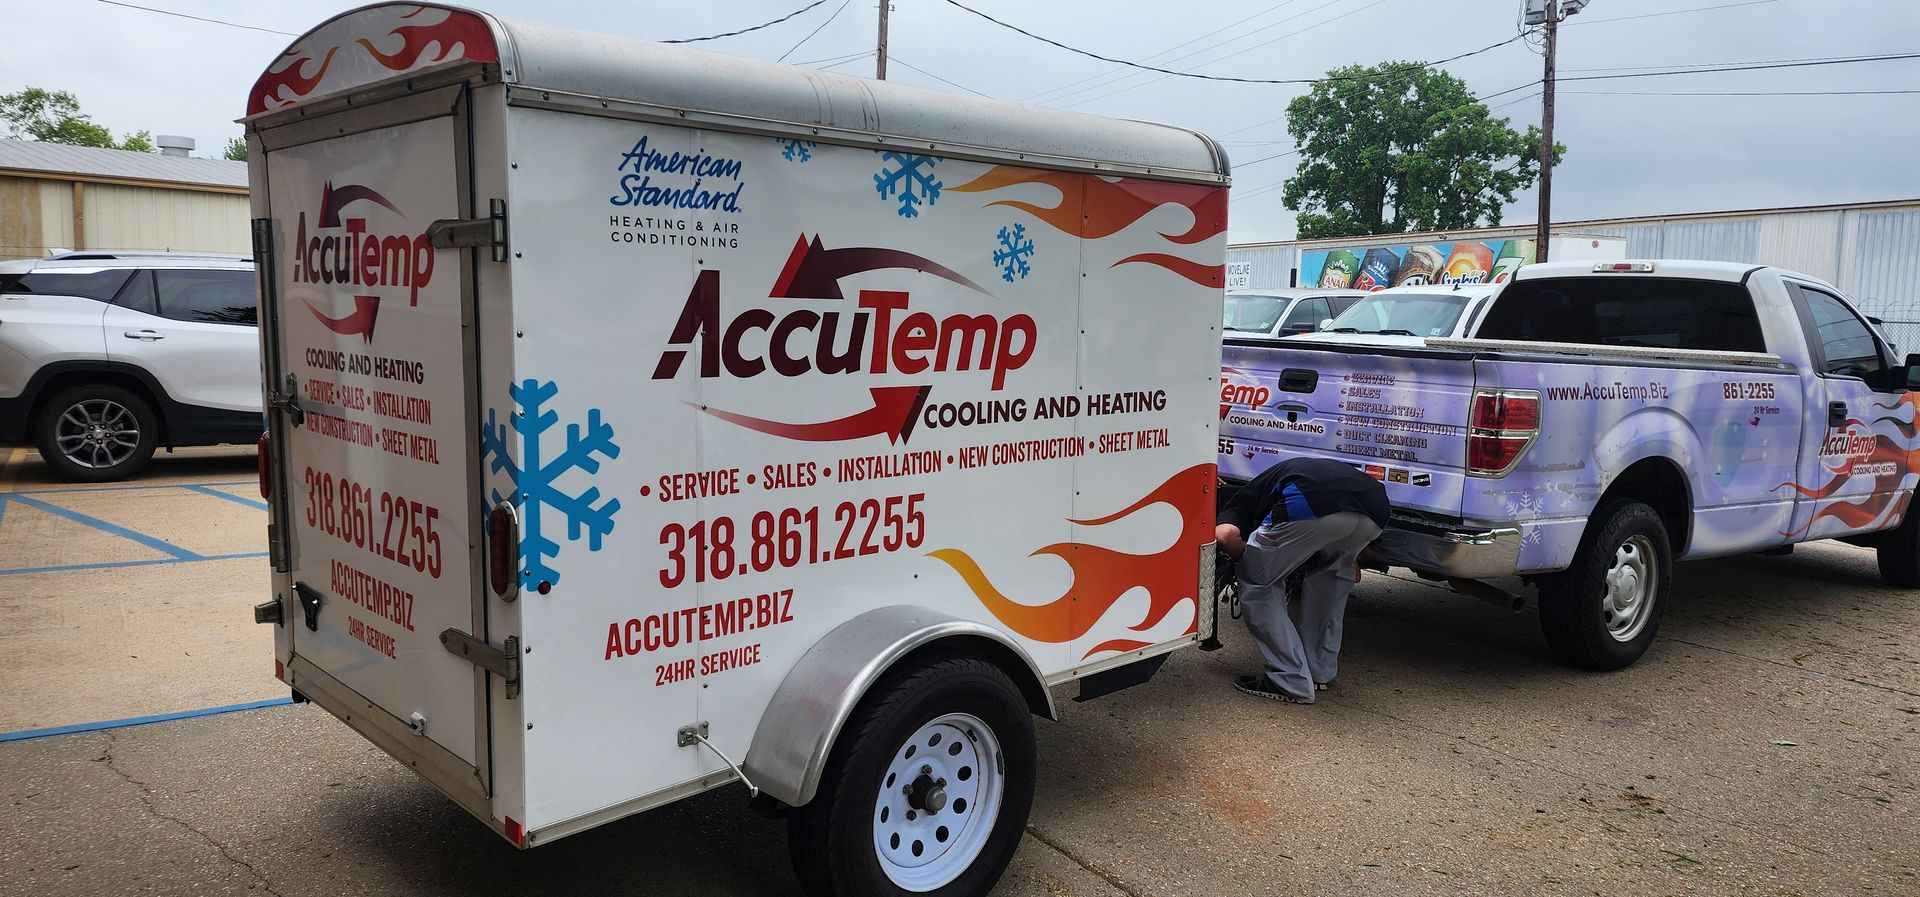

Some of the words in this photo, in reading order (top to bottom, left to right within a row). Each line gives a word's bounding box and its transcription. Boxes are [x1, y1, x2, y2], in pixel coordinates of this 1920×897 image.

[618, 135, 741, 181] American
[610, 174, 744, 213] Standard
[610, 216, 685, 230] HEATING
[696, 221, 704, 231] &
[713, 223, 739, 234] AIR
[611, 232, 738, 248] CONDITIONING
[293, 212, 434, 307] AccuTemp
[1229, 277, 1246, 287] LIVE!
[651, 270, 1037, 391] AccuTemp
[306, 347, 345, 372] COOLING
[349, 354, 371, 376] AND
[374, 357, 424, 384] HEATING
[309, 379, 335, 404] SERVICE
[342, 385, 365, 411] SALES
[373, 391, 431, 425] INSTALLATION
[1348, 387, 1381, 399] SALES
[1547, 382, 1669, 403] www.AccuTemp.Biz
[1723, 382, 1775, 399] 861-2255
[923, 398, 1027, 429] COOLING
[1033, 395, 1081, 420] AND
[1087, 389, 1167, 416] HEATING
[1230, 416, 1264, 427] COOLING
[1267, 420, 1284, 429] AND
[1287, 423, 1324, 434] HEATING
[1345, 415, 1369, 427] NEW
[1372, 418, 1456, 436] CONSTRUCTION
[1346, 401, 1424, 418] INSTALLATION
[1753, 406, 1759, 415] 24
[1765, 406, 1780, 415] Service
[306, 410, 320, 433] NEW
[321, 414, 373, 448] CONSTRUCTION
[382, 428, 408, 457] SHEET
[410, 434, 440, 464] METAL
[1261, 446, 1279, 455] Service
[1344, 429, 1371, 442] DUCT
[1374, 433, 1428, 448] CLEANING
[1380, 447, 1418, 461] METAL
[1819, 426, 1876, 461] AccuTemp
[658, 468, 740, 502] SERVICE
[763, 462, 817, 490] SALES
[838, 450, 942, 483] INSTALLATION
[959, 445, 989, 469] NEW
[992, 436, 1085, 466] CONSTRUCTION
[1099, 431, 1134, 454] SHEET
[1136, 428, 1170, 449] METAL
[1854, 466, 1871, 475] COOLING
[1872, 465, 1880, 474] AND
[1881, 464, 1897, 474] HEATING
[305, 466, 442, 579] 318.861.2255
[659, 493, 925, 588] 318.861.2255
[331, 558, 414, 632] ACCUTEMP.BIZ
[349, 616, 365, 642] 24HR
[366, 623, 396, 660] SERVICE
[604, 588, 794, 660] ACCUTEMP.BIZ
[655, 658, 695, 686] 24HR
[700, 644, 761, 676] SERVICE
